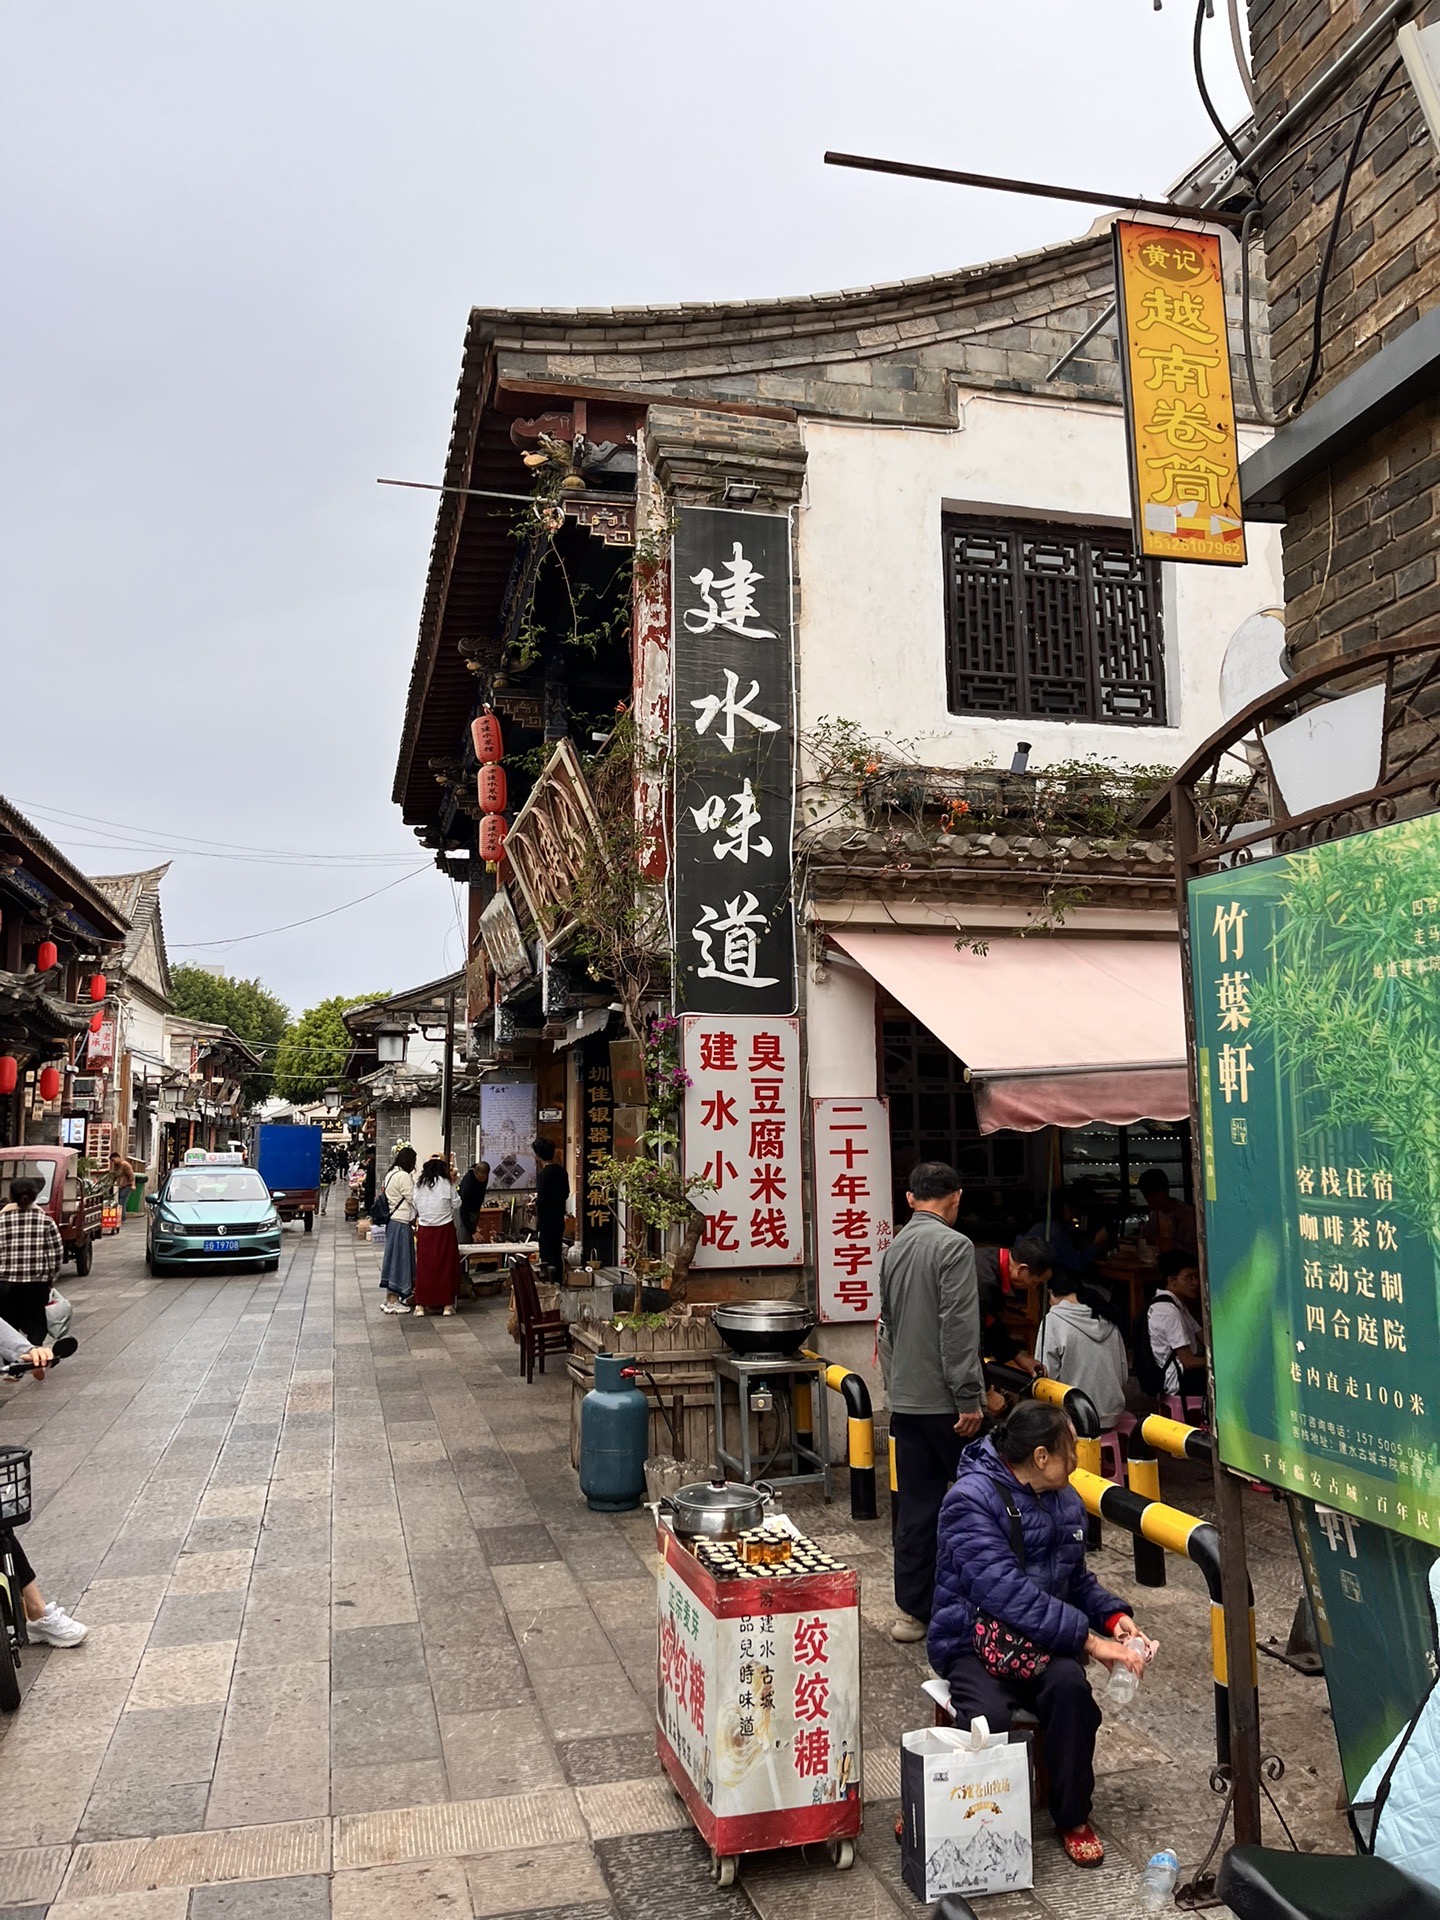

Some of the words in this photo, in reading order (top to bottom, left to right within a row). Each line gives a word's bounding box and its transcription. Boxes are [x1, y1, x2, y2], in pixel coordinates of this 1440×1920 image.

[1143, 244, 1200, 274] 黄记
[1136, 286, 1229, 509] 越南卷筒
[683, 541, 782, 989] 建水味道
[1212, 901, 1255, 1104] 竹葉軒
[700, 1031, 740, 1251] 建水小吃
[748, 1032, 789, 1250] 臭豆腐米线
[829, 1106, 874, 1312] 二十年老字号
[1297, 1165, 1394, 1200] 客栈住宿
[876, 1220, 893, 1253] 烧烤
[1299, 1213, 1398, 1251] 咖啡茶饮
[1304, 1259, 1404, 1304] 活动定制
[1306, 1304, 1407, 1353] 四合庭院
[1290, 1361, 1425, 1416] 巷内直走100米
[667, 1581, 699, 1641] 正宗麦芽
[793, 1616, 831, 1779] 绞绞糖
